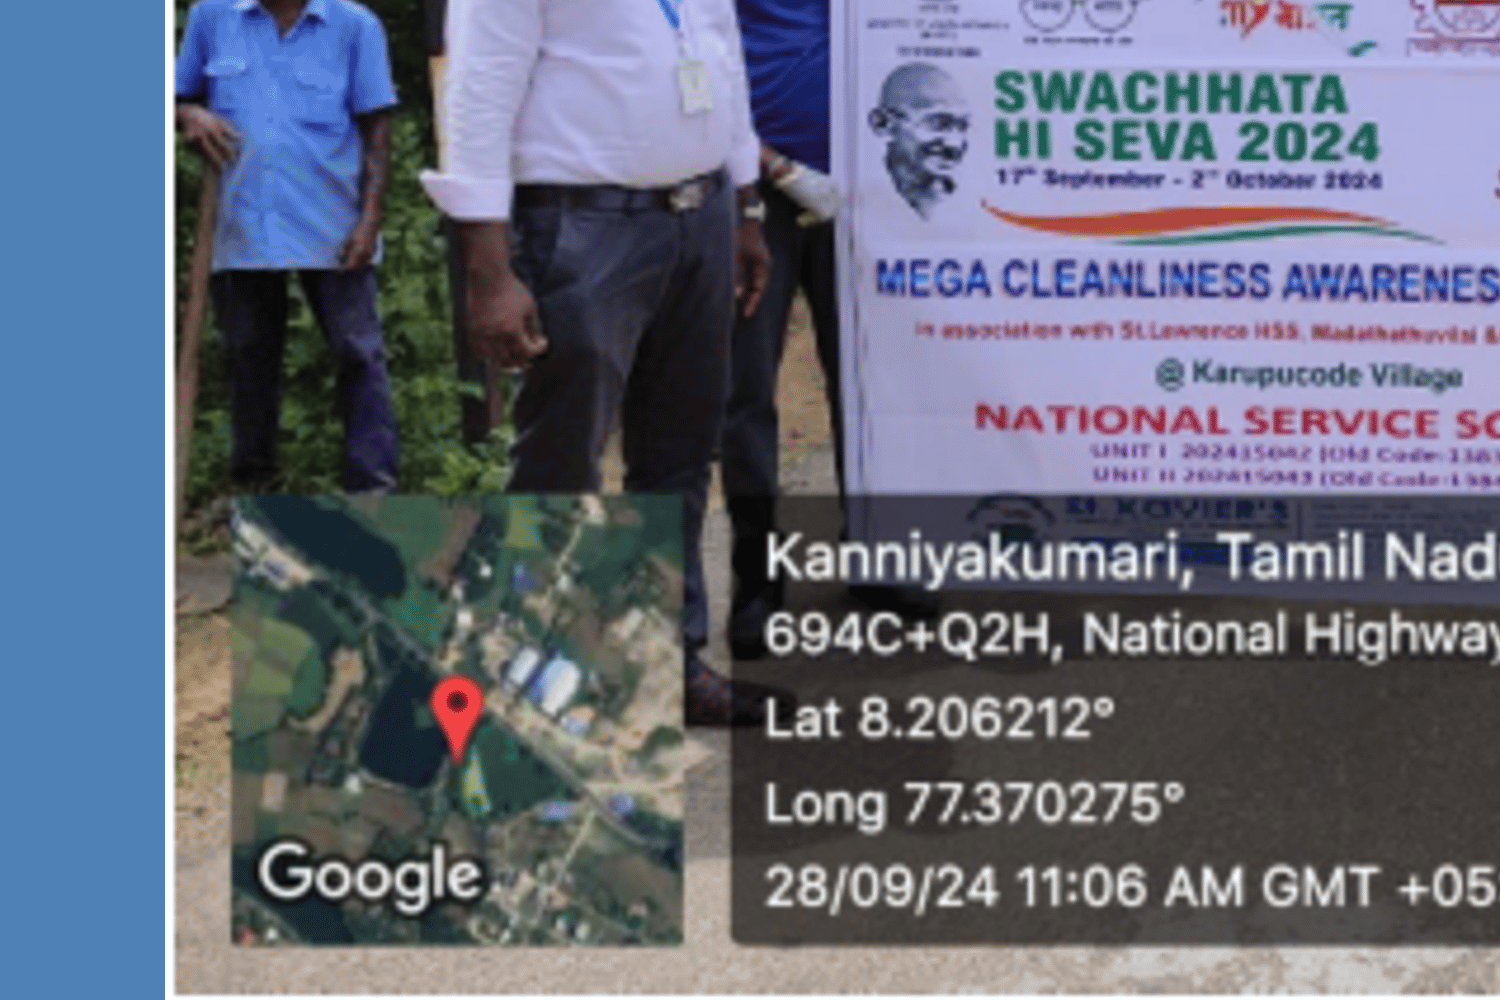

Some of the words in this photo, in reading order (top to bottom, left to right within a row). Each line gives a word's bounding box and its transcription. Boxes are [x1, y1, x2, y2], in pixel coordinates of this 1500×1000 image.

[994, 69, 1349, 114] SWACHHATA
[994, 118, 1052, 160] HI
[1073, 118, 1217, 161] SEVA
[1237, 120, 1380, 162] 2024
[1042, 168, 1166, 190] September
[1226, 169, 1317, 189] October
[1324, 170, 1383, 190] 2024
[875, 257, 992, 298] MEGA
[1002, 258, 1272, 301] CLEANLINESS
[941, 320, 1062, 340] association
[1069, 320, 1114, 340] with
[1154, 356, 1185, 393] @
[1192, 358, 1364, 391] Karupucode
[1369, 361, 1464, 396] Village
[975, 404, 1230, 436] NATIONAL
[1243, 406, 1440, 440] SERVICE
[1090, 442, 1152, 460] UNIT
[1092, 467, 1150, 484] UNIT
